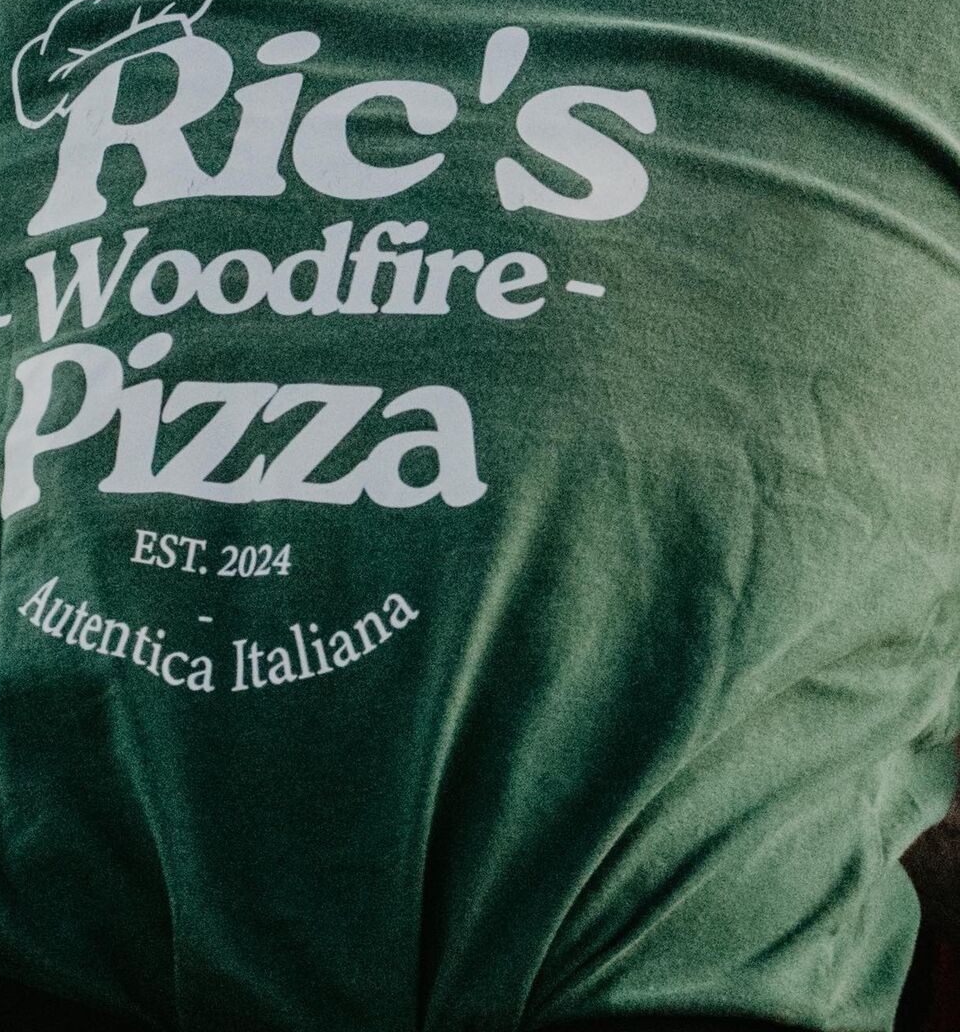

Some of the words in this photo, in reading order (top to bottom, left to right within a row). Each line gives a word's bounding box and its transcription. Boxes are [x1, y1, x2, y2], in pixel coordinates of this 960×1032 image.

[26, 25, 657, 237] Ric's
[25, 220, 548, 343] Woodfire
[0, 332, 488, 521] Pizza
[130, 529, 208, 575] EST.
[216, 544, 292, 577] 2024
[18, 576, 216, 693] Autentica
[231, 593, 420, 692] Italiana
